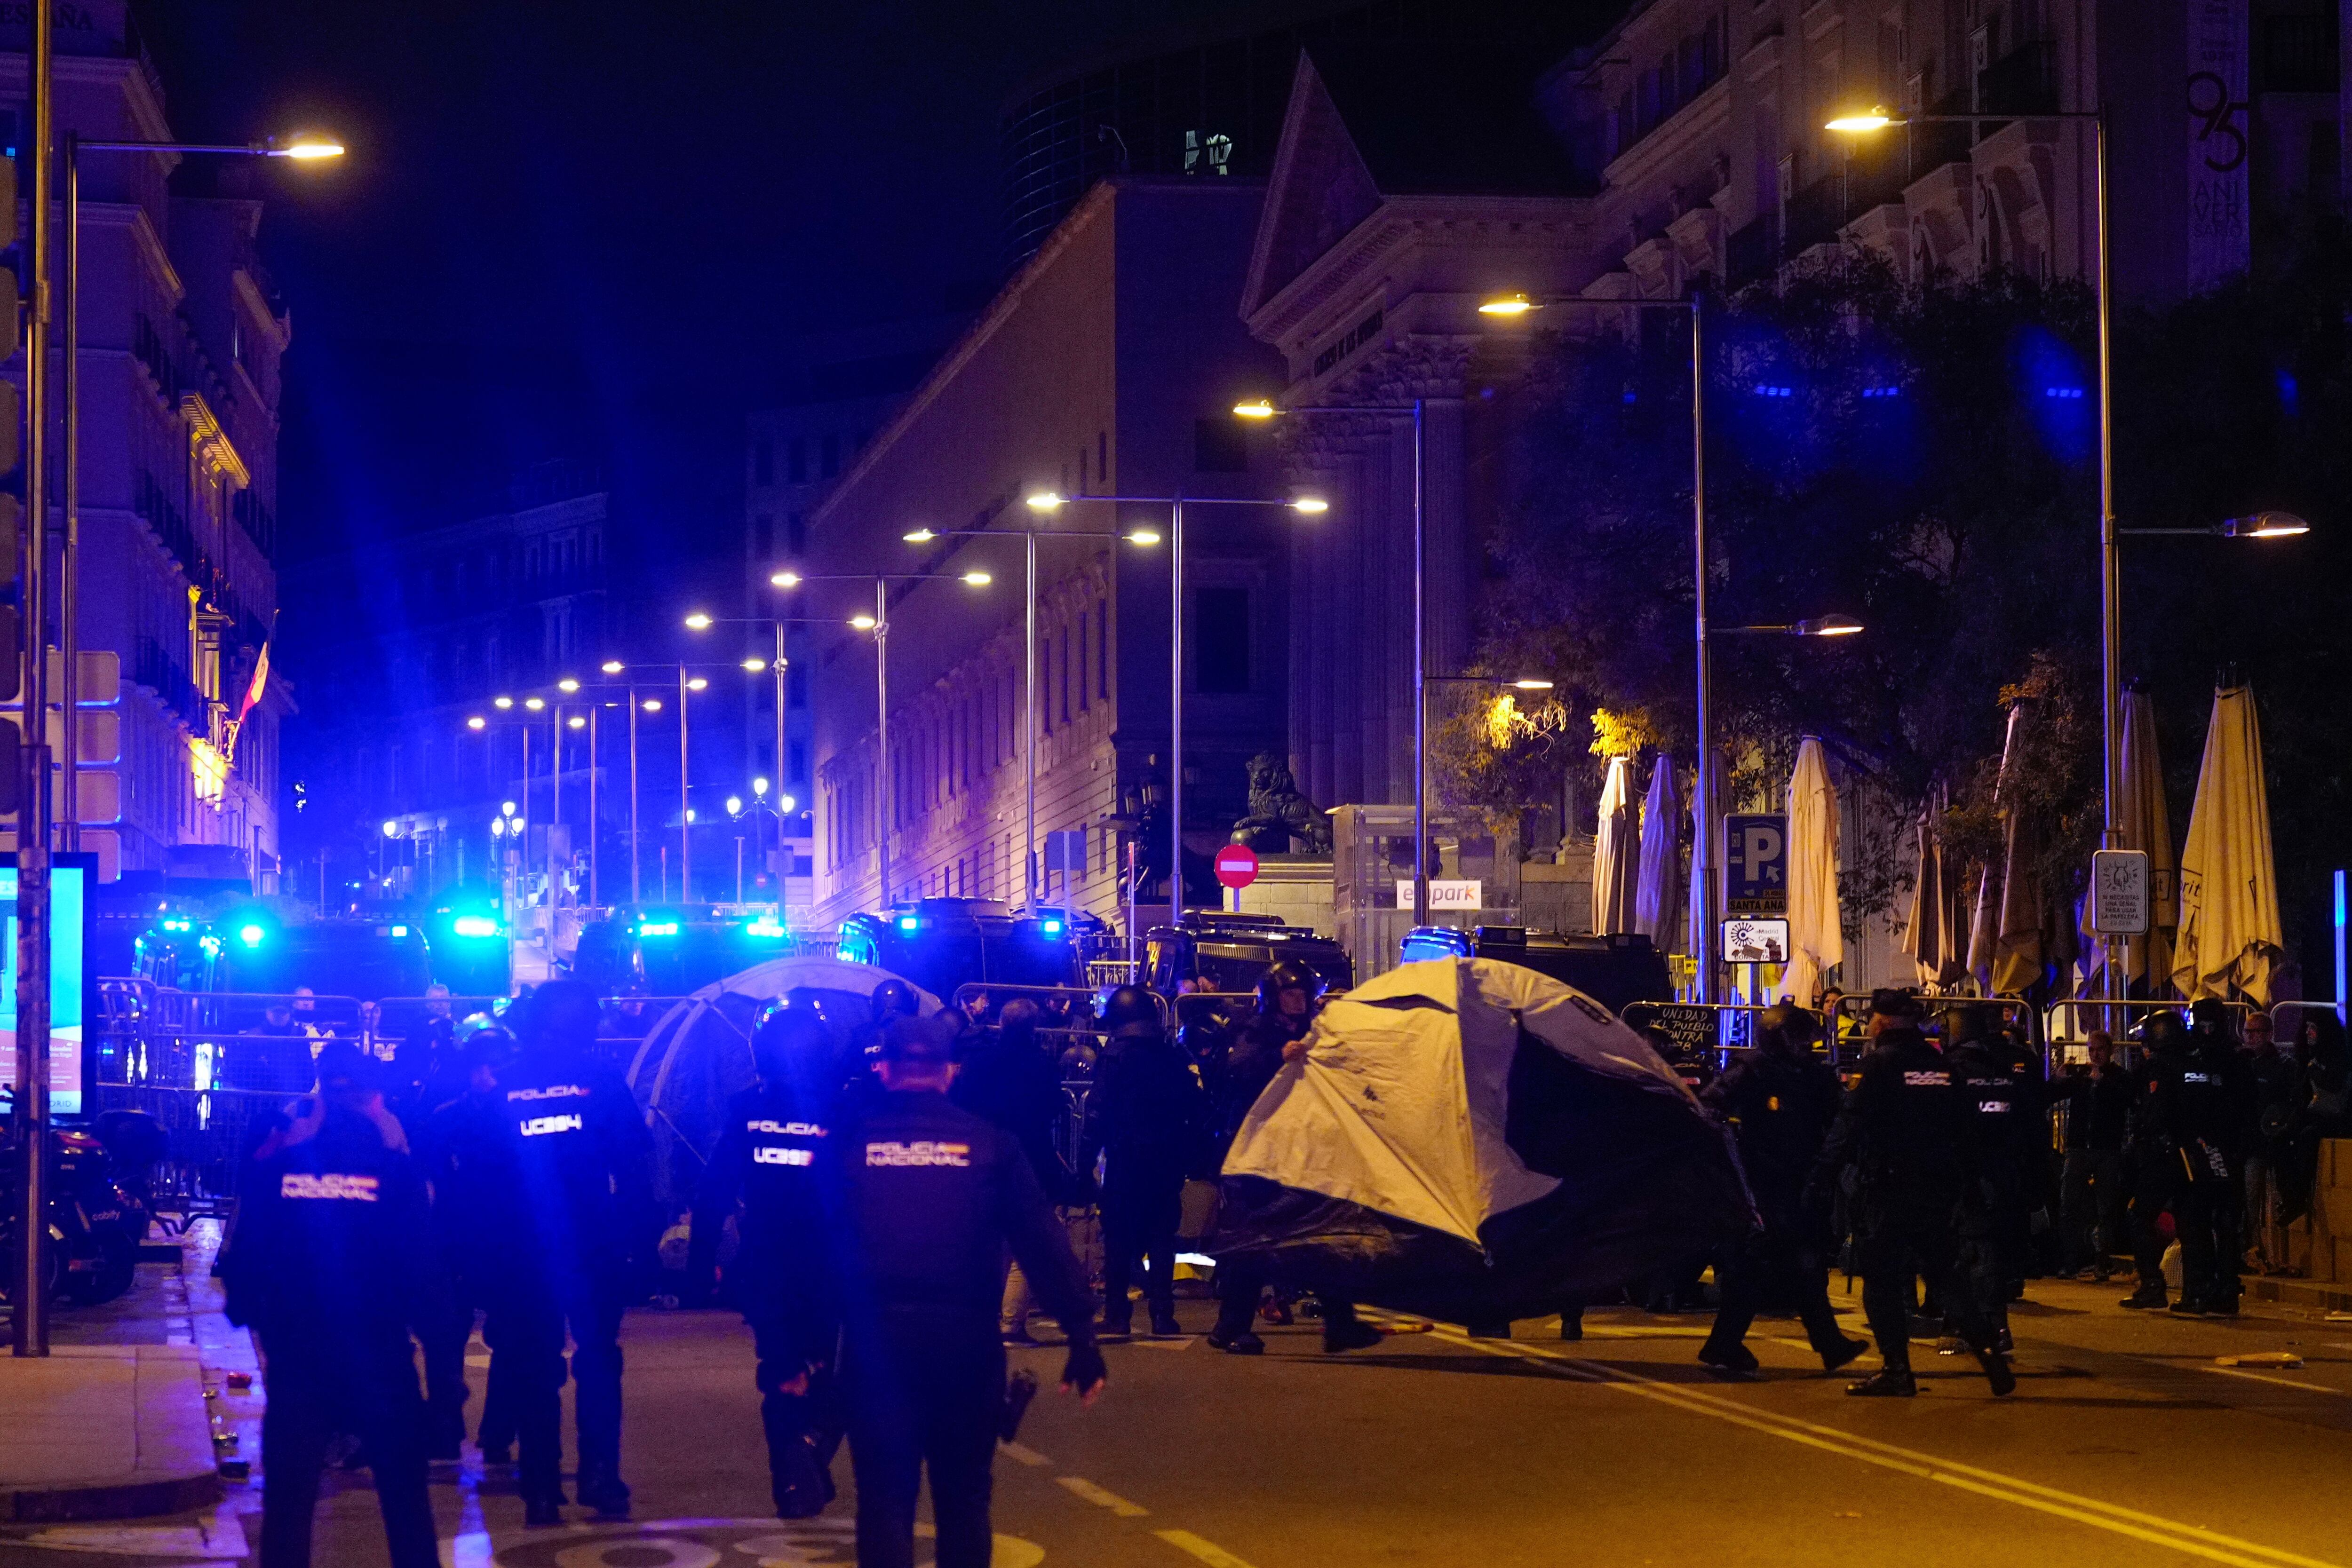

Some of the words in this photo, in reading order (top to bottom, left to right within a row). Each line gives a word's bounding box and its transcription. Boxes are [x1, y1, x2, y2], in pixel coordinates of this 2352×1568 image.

[2186, 71, 2248, 172] 95
[2194, 180, 2238, 202] ANI
[2194, 202, 2240, 224] VER
[1745, 827, 1781, 881] P
[1403, 886, 1474, 904] epark
[1730, 901, 1761, 910] SANTA
[1764, 901, 1784, 910] ANA
[1662, 1007, 1708, 1022] UNIDAD
[1672, 1020, 1714, 1032] PUEBLO
[747, 1120, 821, 1136] POLICIA
